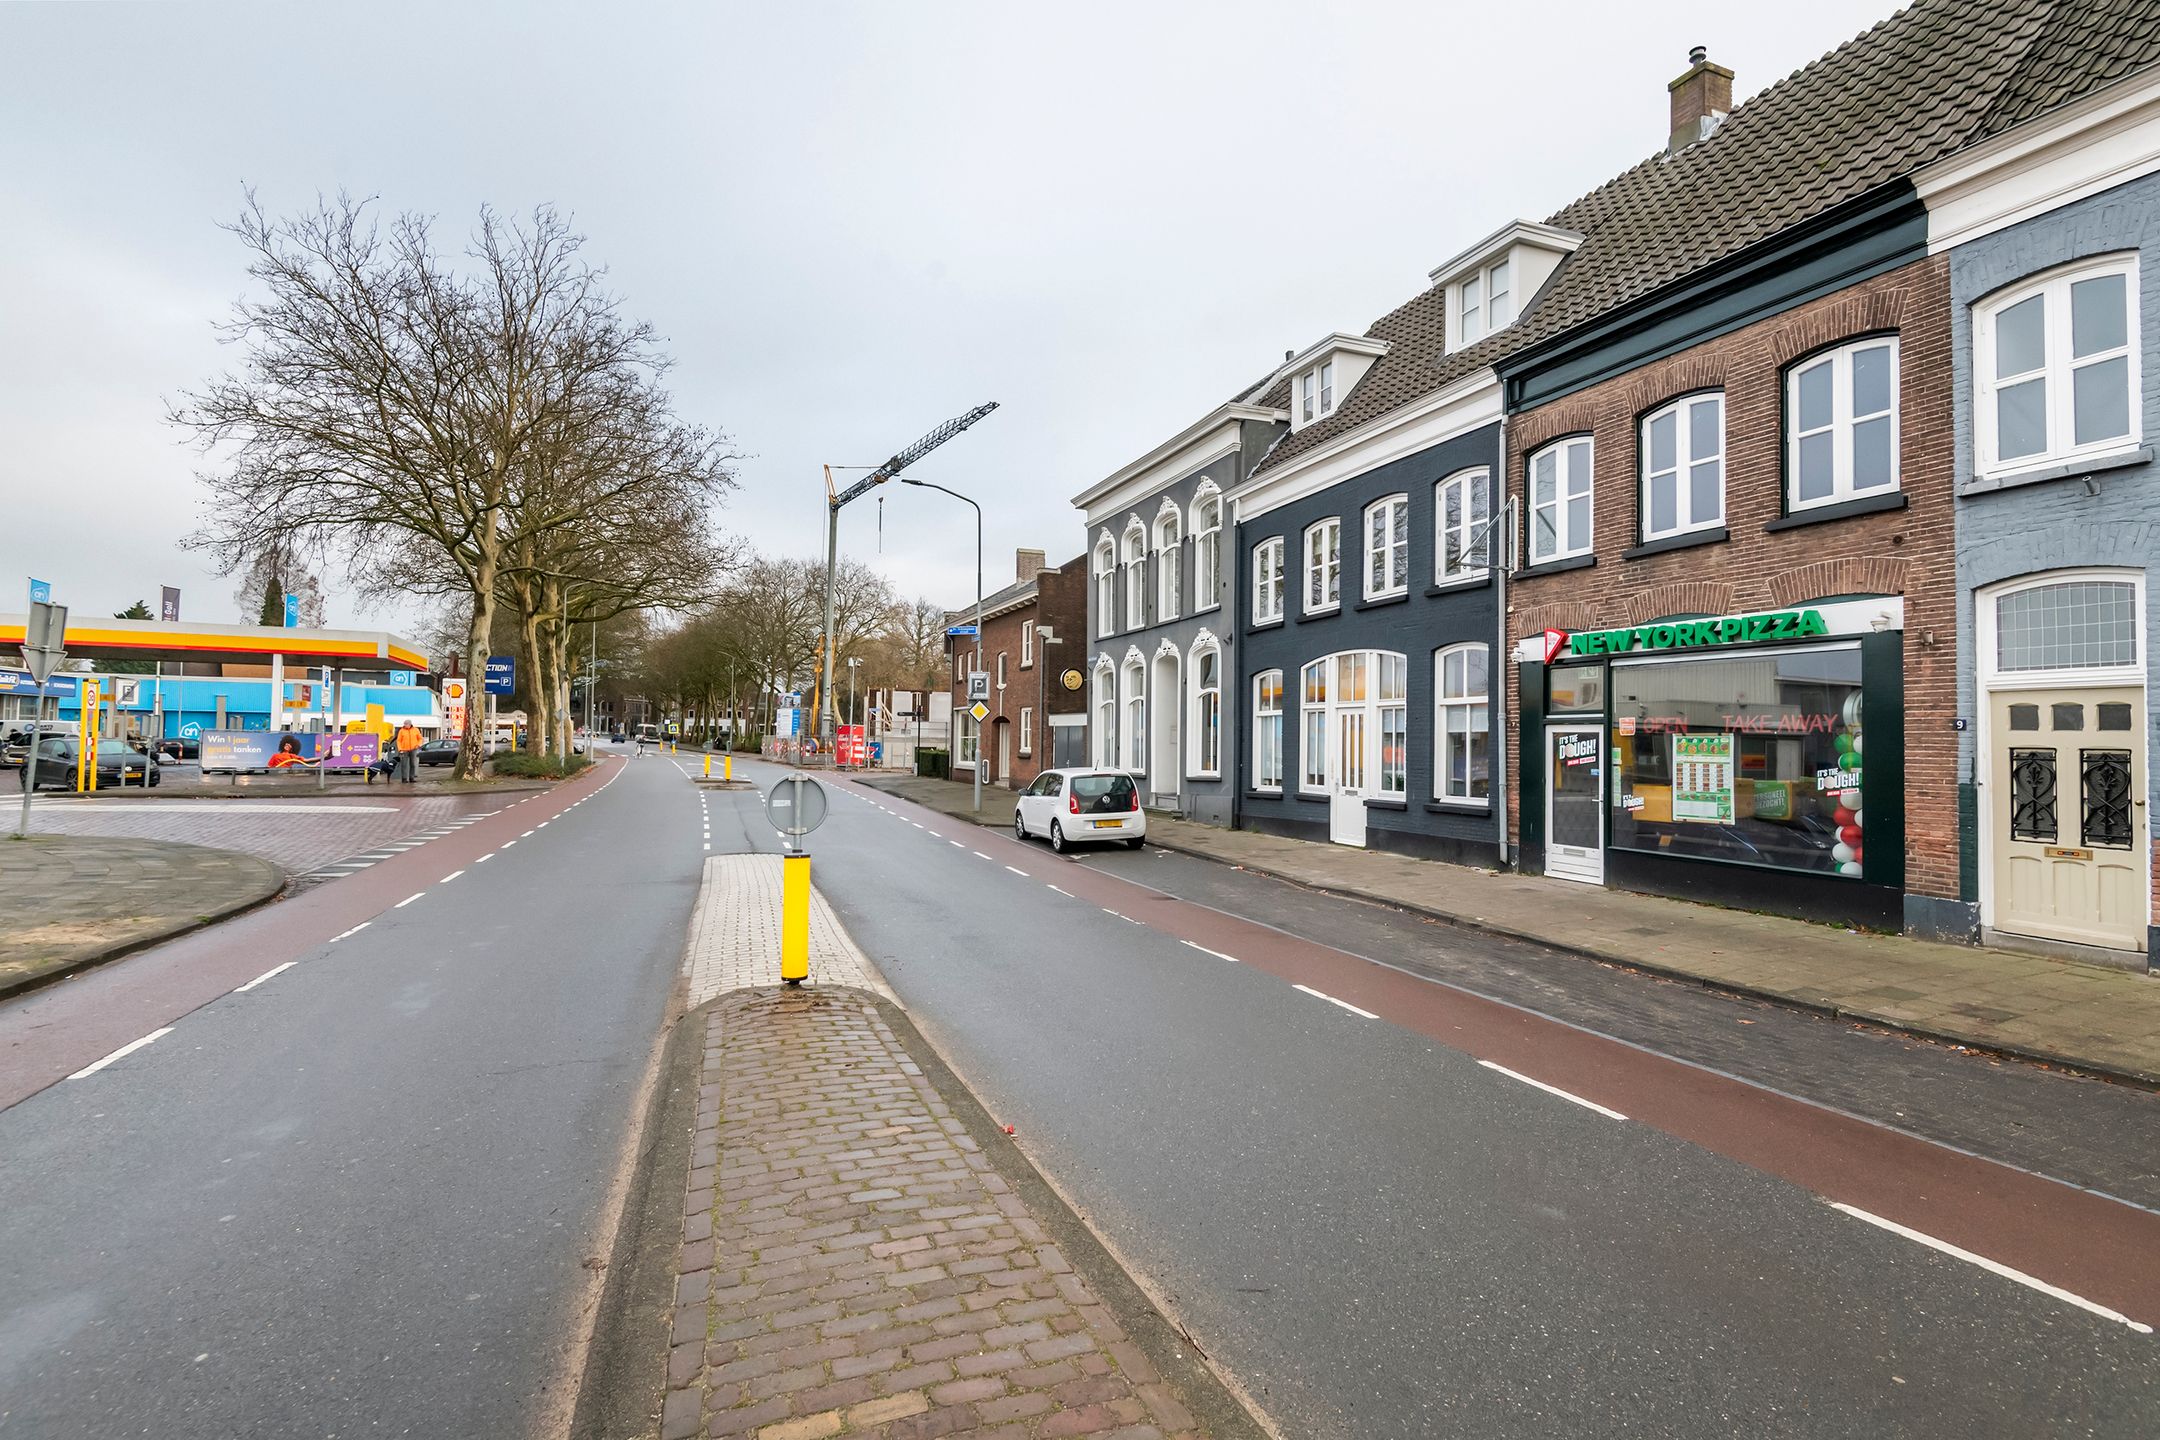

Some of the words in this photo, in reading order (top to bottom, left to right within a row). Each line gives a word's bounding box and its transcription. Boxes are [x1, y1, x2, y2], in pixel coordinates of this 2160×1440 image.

[1570, 630, 1636, 655] NEW
[1634, 620, 1722, 649] YORK
[1720, 609, 1830, 642] PIZZA
[974, 680, 984, 692] P
[1643, 717, 1688, 734] OPEN
[1722, 715, 1773, 733] TAKE
[1776, 714, 1838, 733] AWAY
[1956, 720, 1964, 730] 9
[233, 736, 250, 745] jaar
[1559, 735, 1569, 745] IT'S
[1569, 734, 1578, 743] THE
[233, 745, 262, 753] tanken
[1816, 769, 1828, 778] IT'S
[1828, 767, 1839, 776] THE
